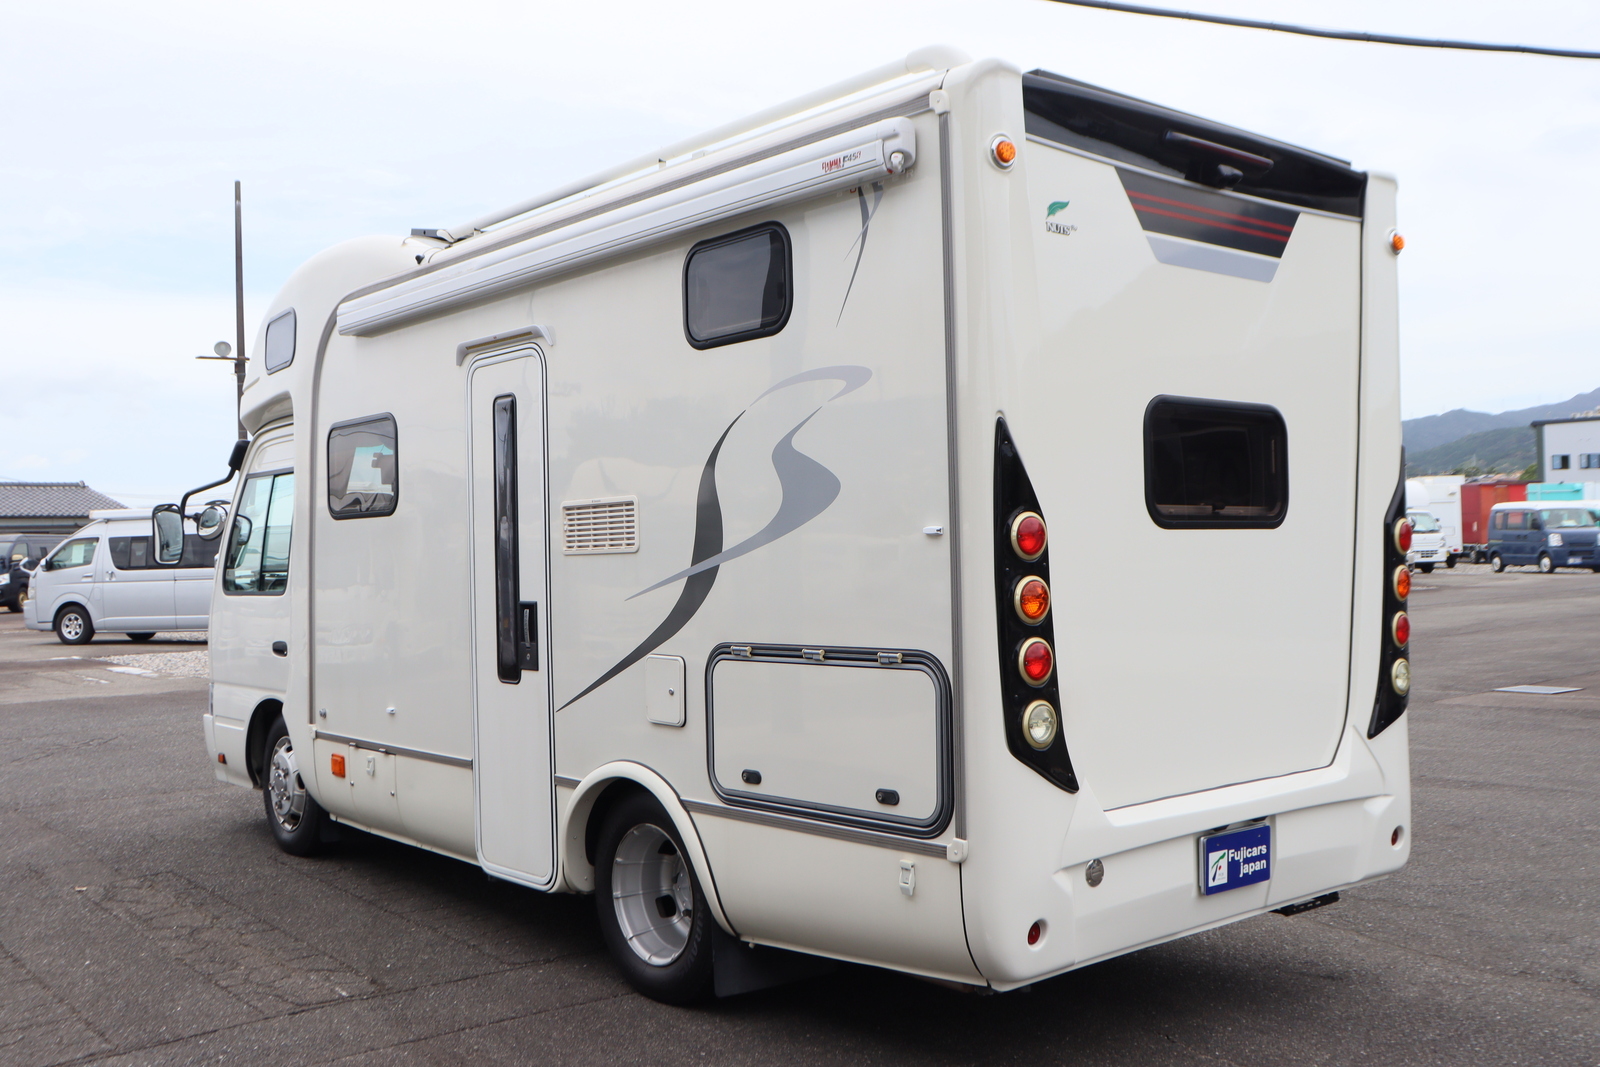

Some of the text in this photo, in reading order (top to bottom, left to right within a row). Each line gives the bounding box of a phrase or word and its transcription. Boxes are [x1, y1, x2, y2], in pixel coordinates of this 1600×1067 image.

[1045, 220, 1071, 236] NUTS
[1228, 844, 1267, 862] Fujicars
[1239, 859, 1267, 878] japan
